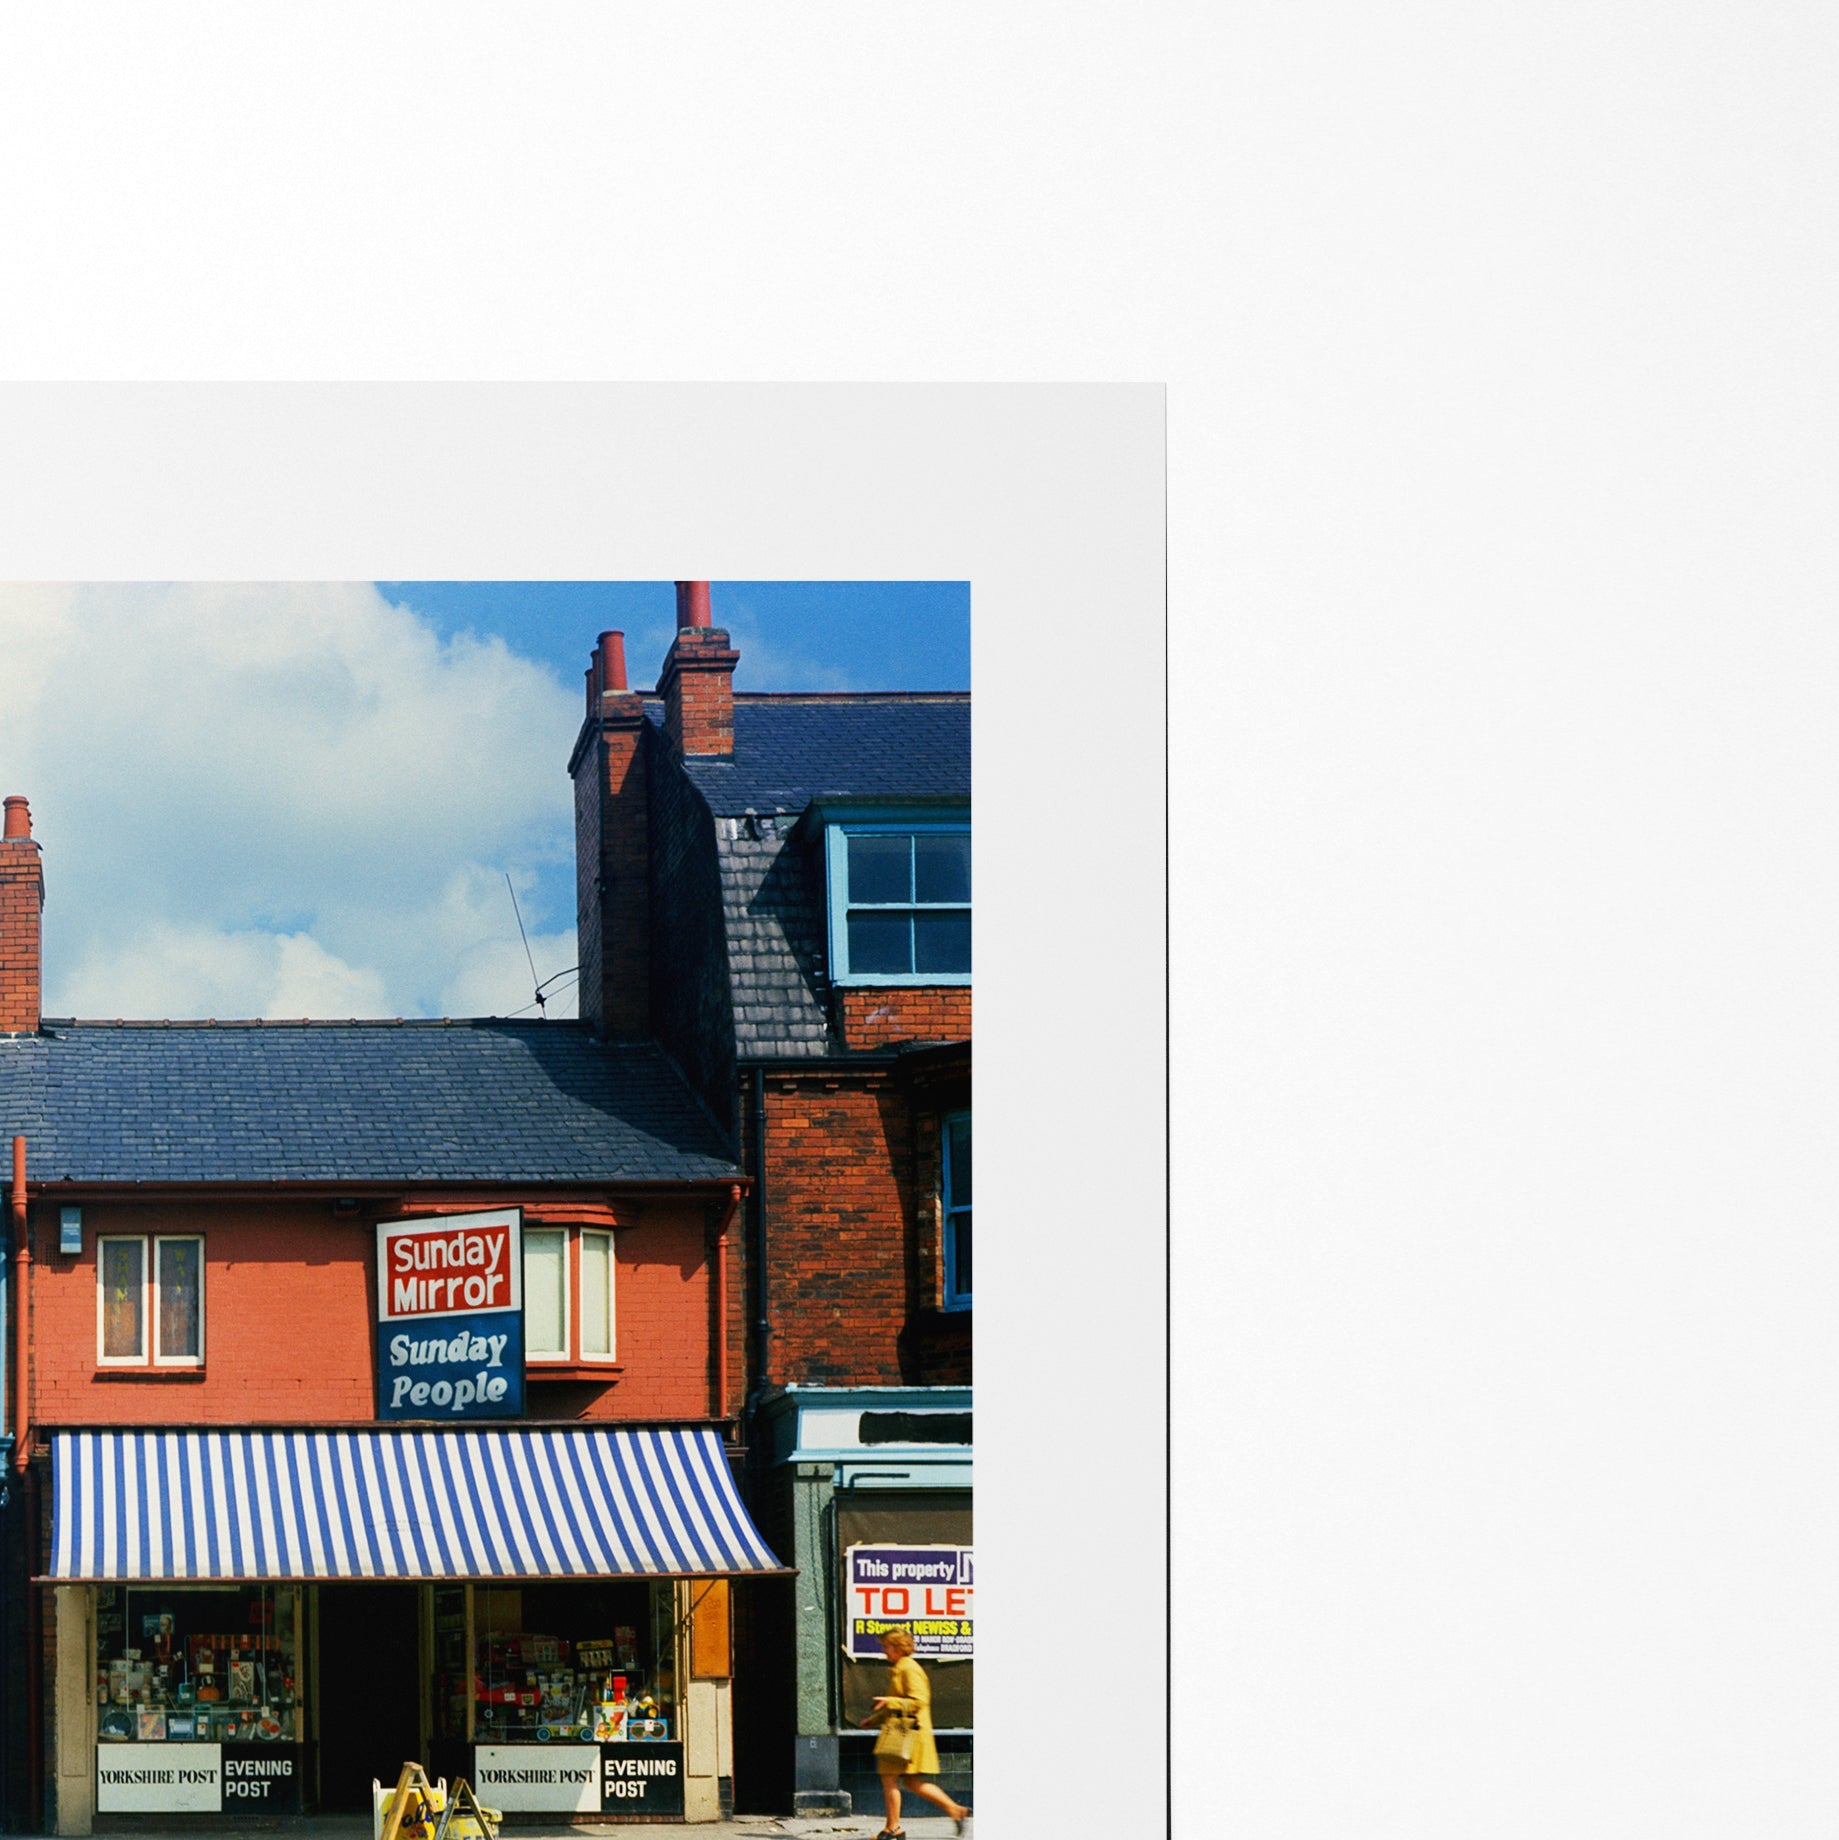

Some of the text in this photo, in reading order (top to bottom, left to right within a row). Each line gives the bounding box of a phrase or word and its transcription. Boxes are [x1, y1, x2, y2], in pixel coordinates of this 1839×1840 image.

[394, 1232, 504, 1275] Sunday
[394, 1274, 503, 1313] Mirror
[390, 1331, 507, 1367] Sunday
[390, 1371, 507, 1411] People
[857, 1559, 889, 1577] This
[892, 1561, 955, 1581] property
[856, 1587, 909, 1615] TO
[856, 1620, 864, 1634] R
[913, 1621, 958, 1635] NEWISS
[961, 1621, 971, 1635] &
[100, 1769, 217, 1784] YORKSHIRE POST
[225, 1760, 292, 1776] EVENING
[479, 1769, 595, 1783] YORKSHIRE POST
[605, 1759, 676, 1776] EVENING
[226, 1781, 271, 1797] POST
[605, 1780, 647, 1798] POST
